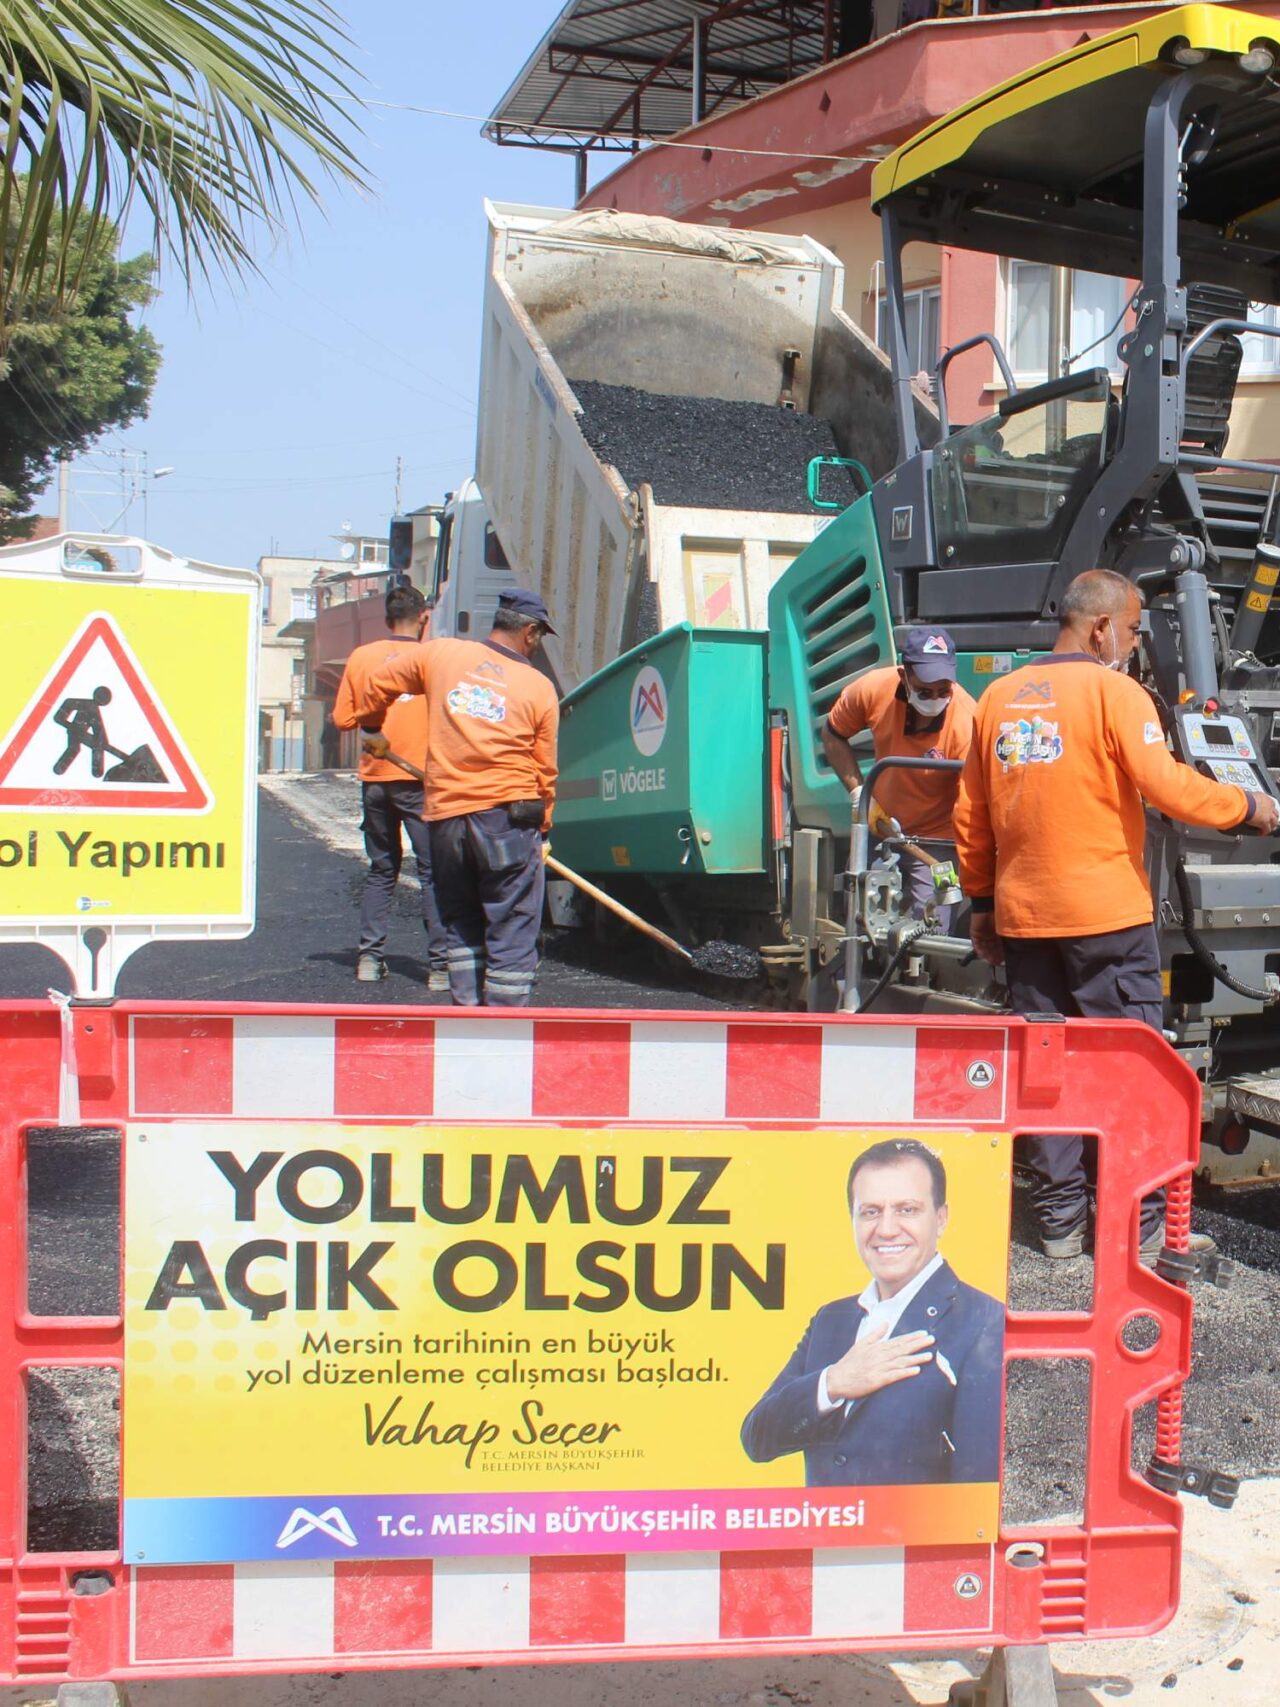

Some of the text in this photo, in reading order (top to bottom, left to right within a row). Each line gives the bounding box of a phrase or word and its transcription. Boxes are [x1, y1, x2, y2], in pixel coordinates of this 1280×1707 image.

[620, 766, 666, 794] VÖGELE
[0, 830, 225, 877] ol Yapımı
[206, 1149, 732, 1226] YOLUMUZ
[145, 1239, 786, 1321] AÇIK OLSUN
[302, 1329, 675, 1360] Mersin tarihinin en büyük
[246, 1358, 728, 1392] yol düzenleme çalışması başladı.
[364, 1395, 621, 1469] Vahap Seçer
[482, 1461, 600, 1473] BELEDİYE BAŞKANI
[508, 1449, 558, 1460] MERSİN
[377, 1499, 864, 1538] T.C. MERSİN BÜYÜKŞEHİR BELEDİYESİ
